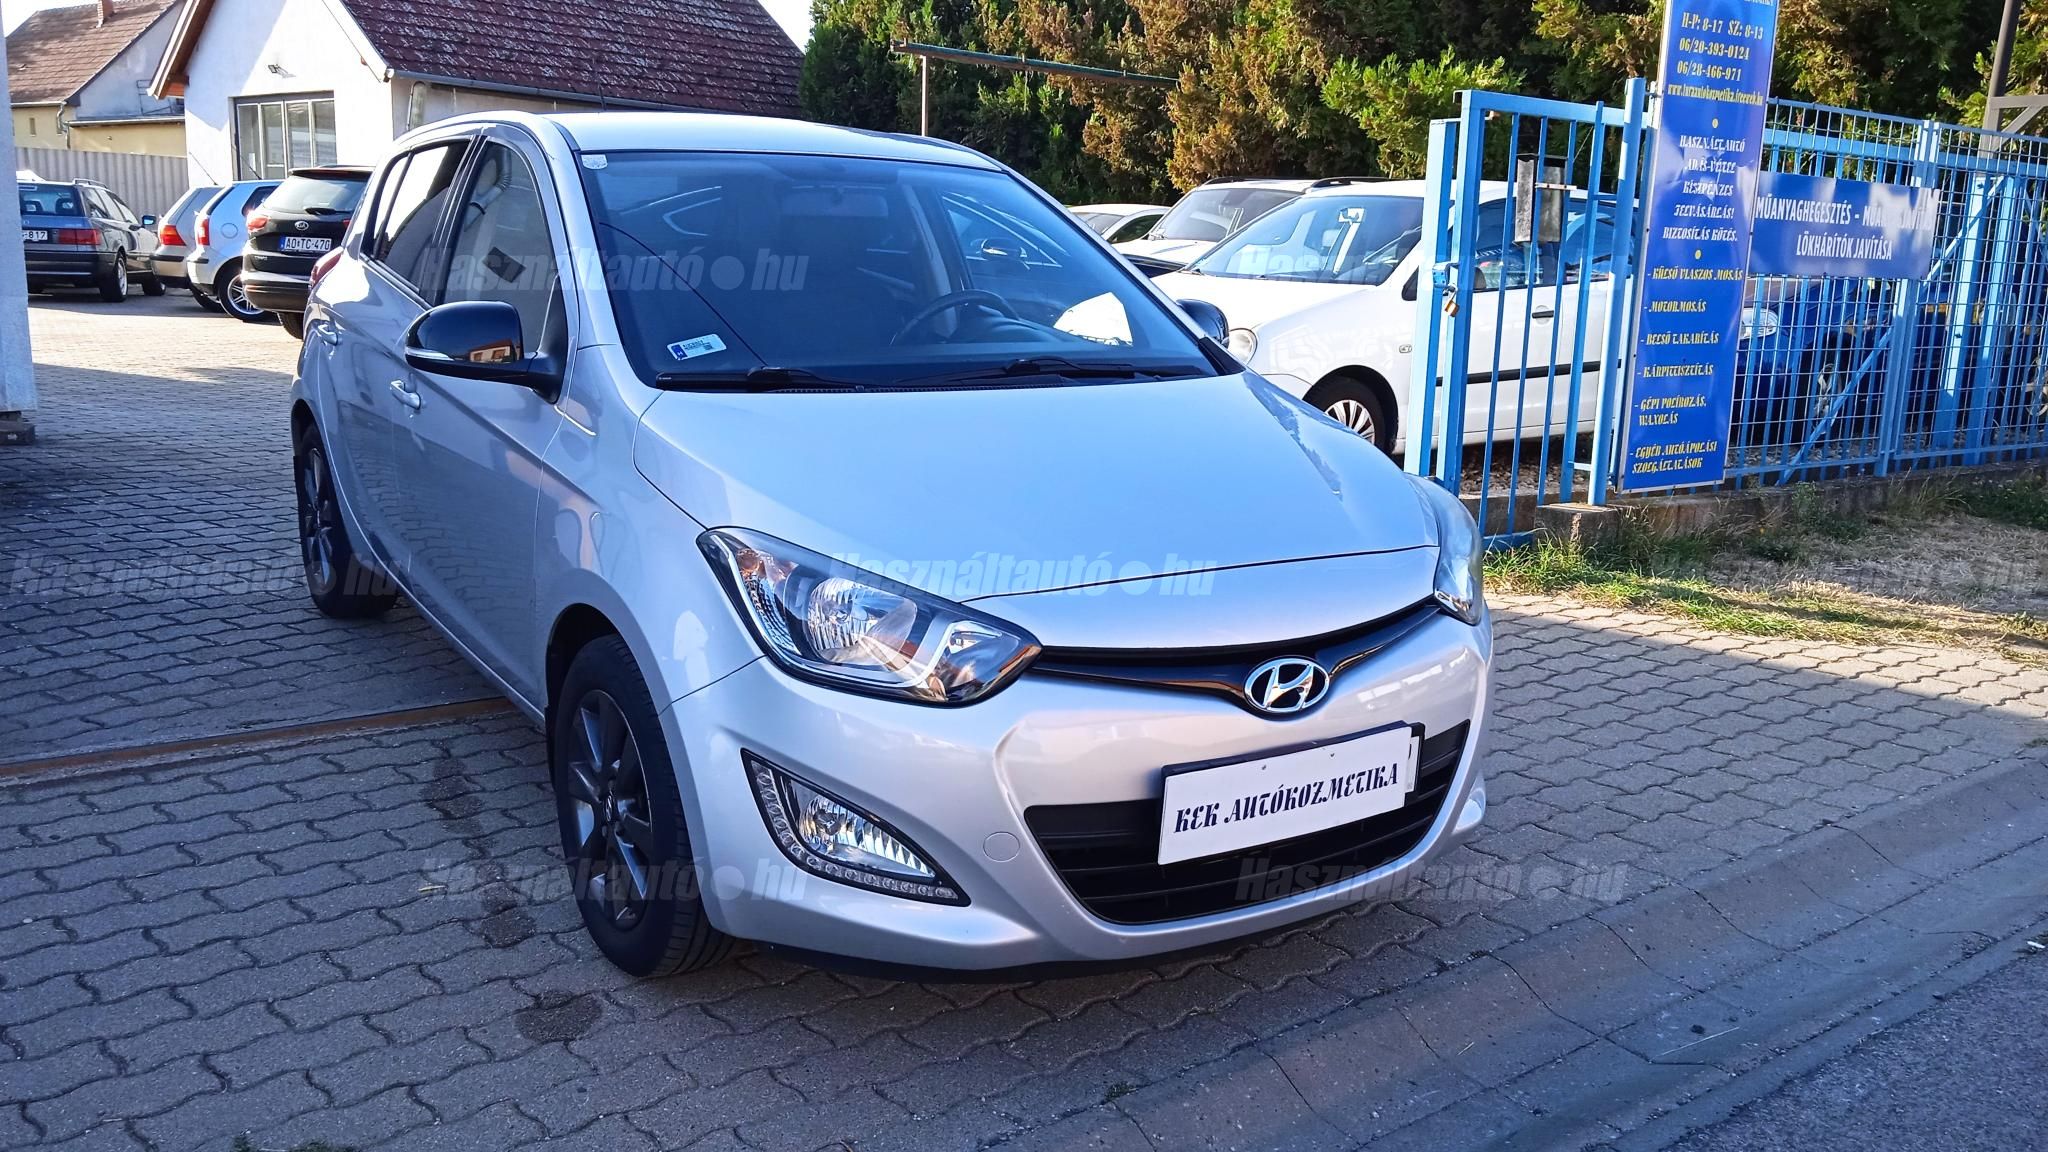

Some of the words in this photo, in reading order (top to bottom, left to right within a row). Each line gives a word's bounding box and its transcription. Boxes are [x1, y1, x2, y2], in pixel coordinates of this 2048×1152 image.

[1682, 12, 1701, 31] H-P:
[1702, 18, 1723, 34] 8-17
[1727, 19, 1742, 37] SZ:
[1744, 24, 1764, 40] 8-13
[1680, 37, 1750, 60] 06/20-393-0124
[1755, 193, 1852, 225] MŰANYAGHEGESZTÉS
[1796, 231, 1854, 258] LÖKHÁRÍTÓK
[1853, 235, 1893, 260] JAVÍTÁSA
[1174, 801, 1220, 834] KEK
[1224, 763, 1399, 824] AUTÓKOZMETIKA
